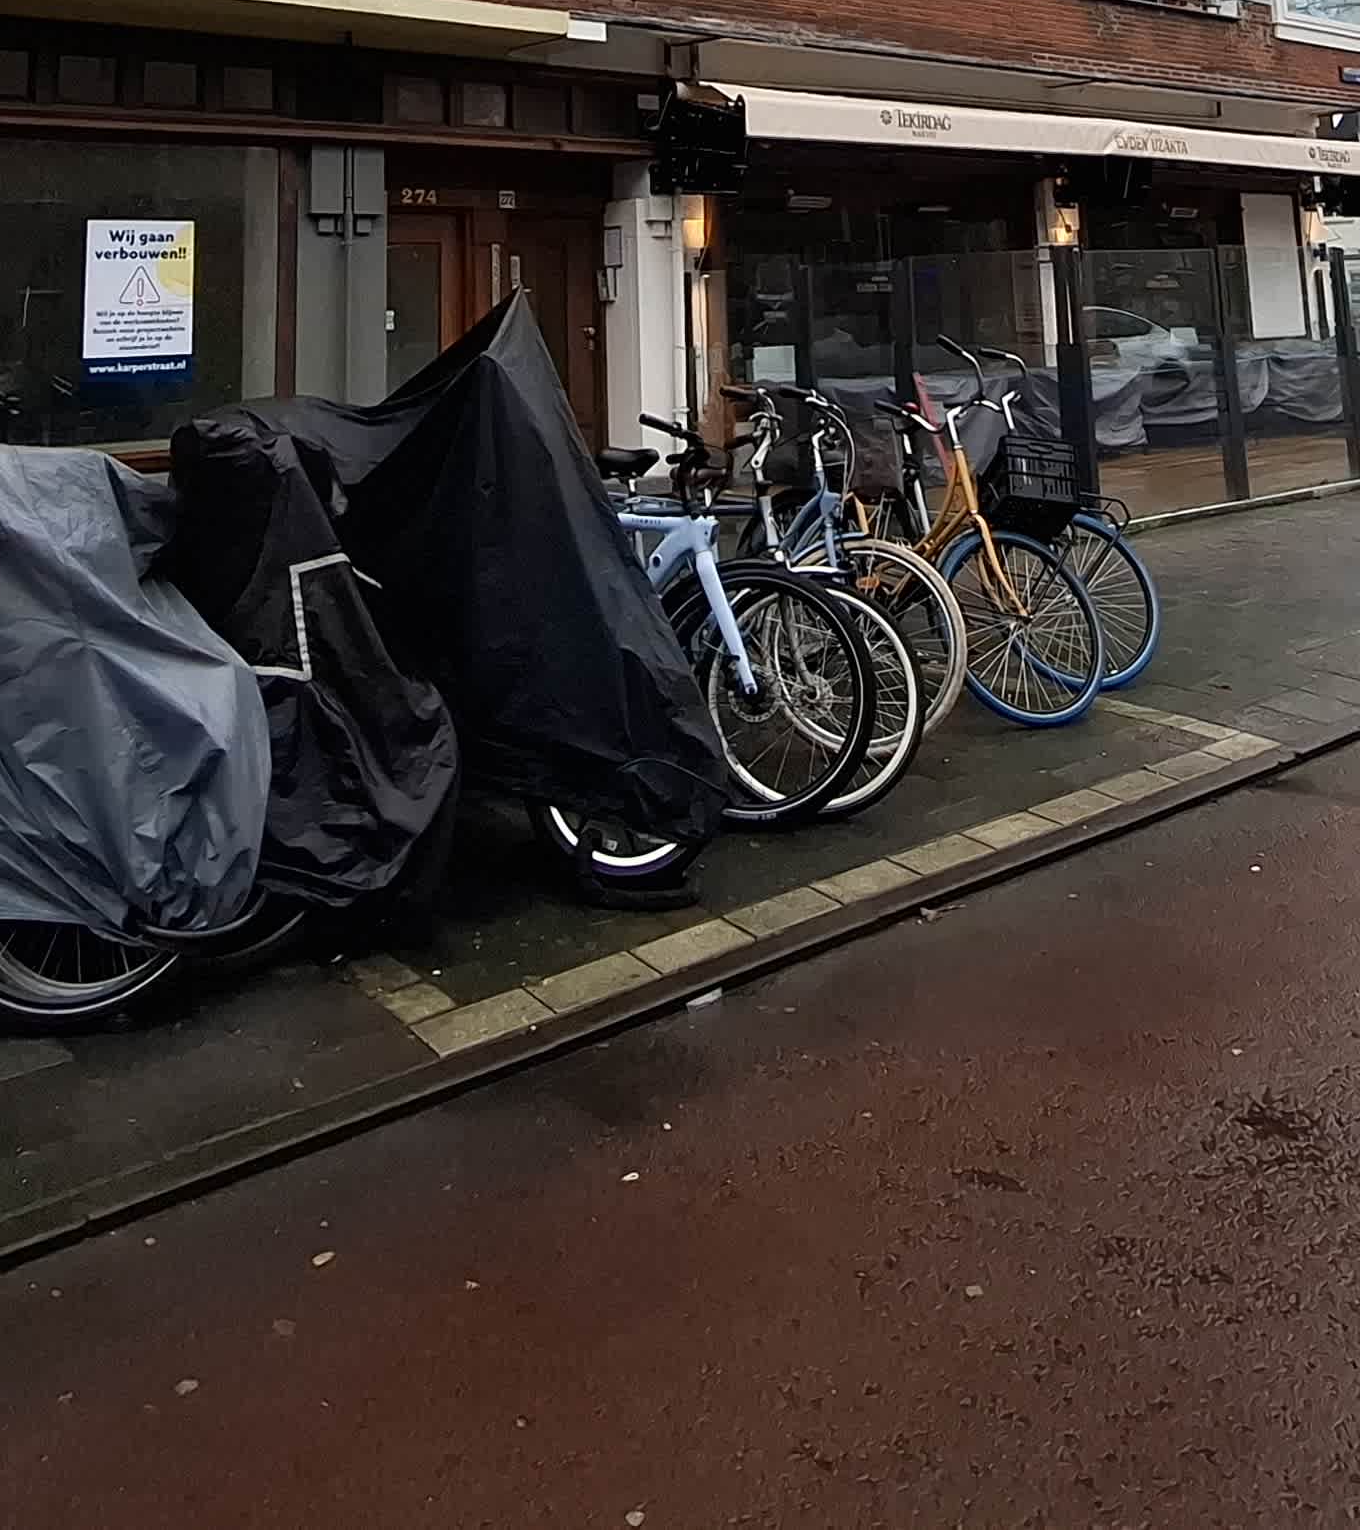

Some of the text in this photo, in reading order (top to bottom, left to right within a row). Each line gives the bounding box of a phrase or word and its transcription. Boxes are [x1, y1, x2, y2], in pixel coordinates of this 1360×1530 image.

[401, 188, 438, 205] 274
[109, 230, 174, 246] Wij gaan
[95, 247, 187, 260] verbouwen!!
[88, 359, 187, 375] www.karperstraat.nl
